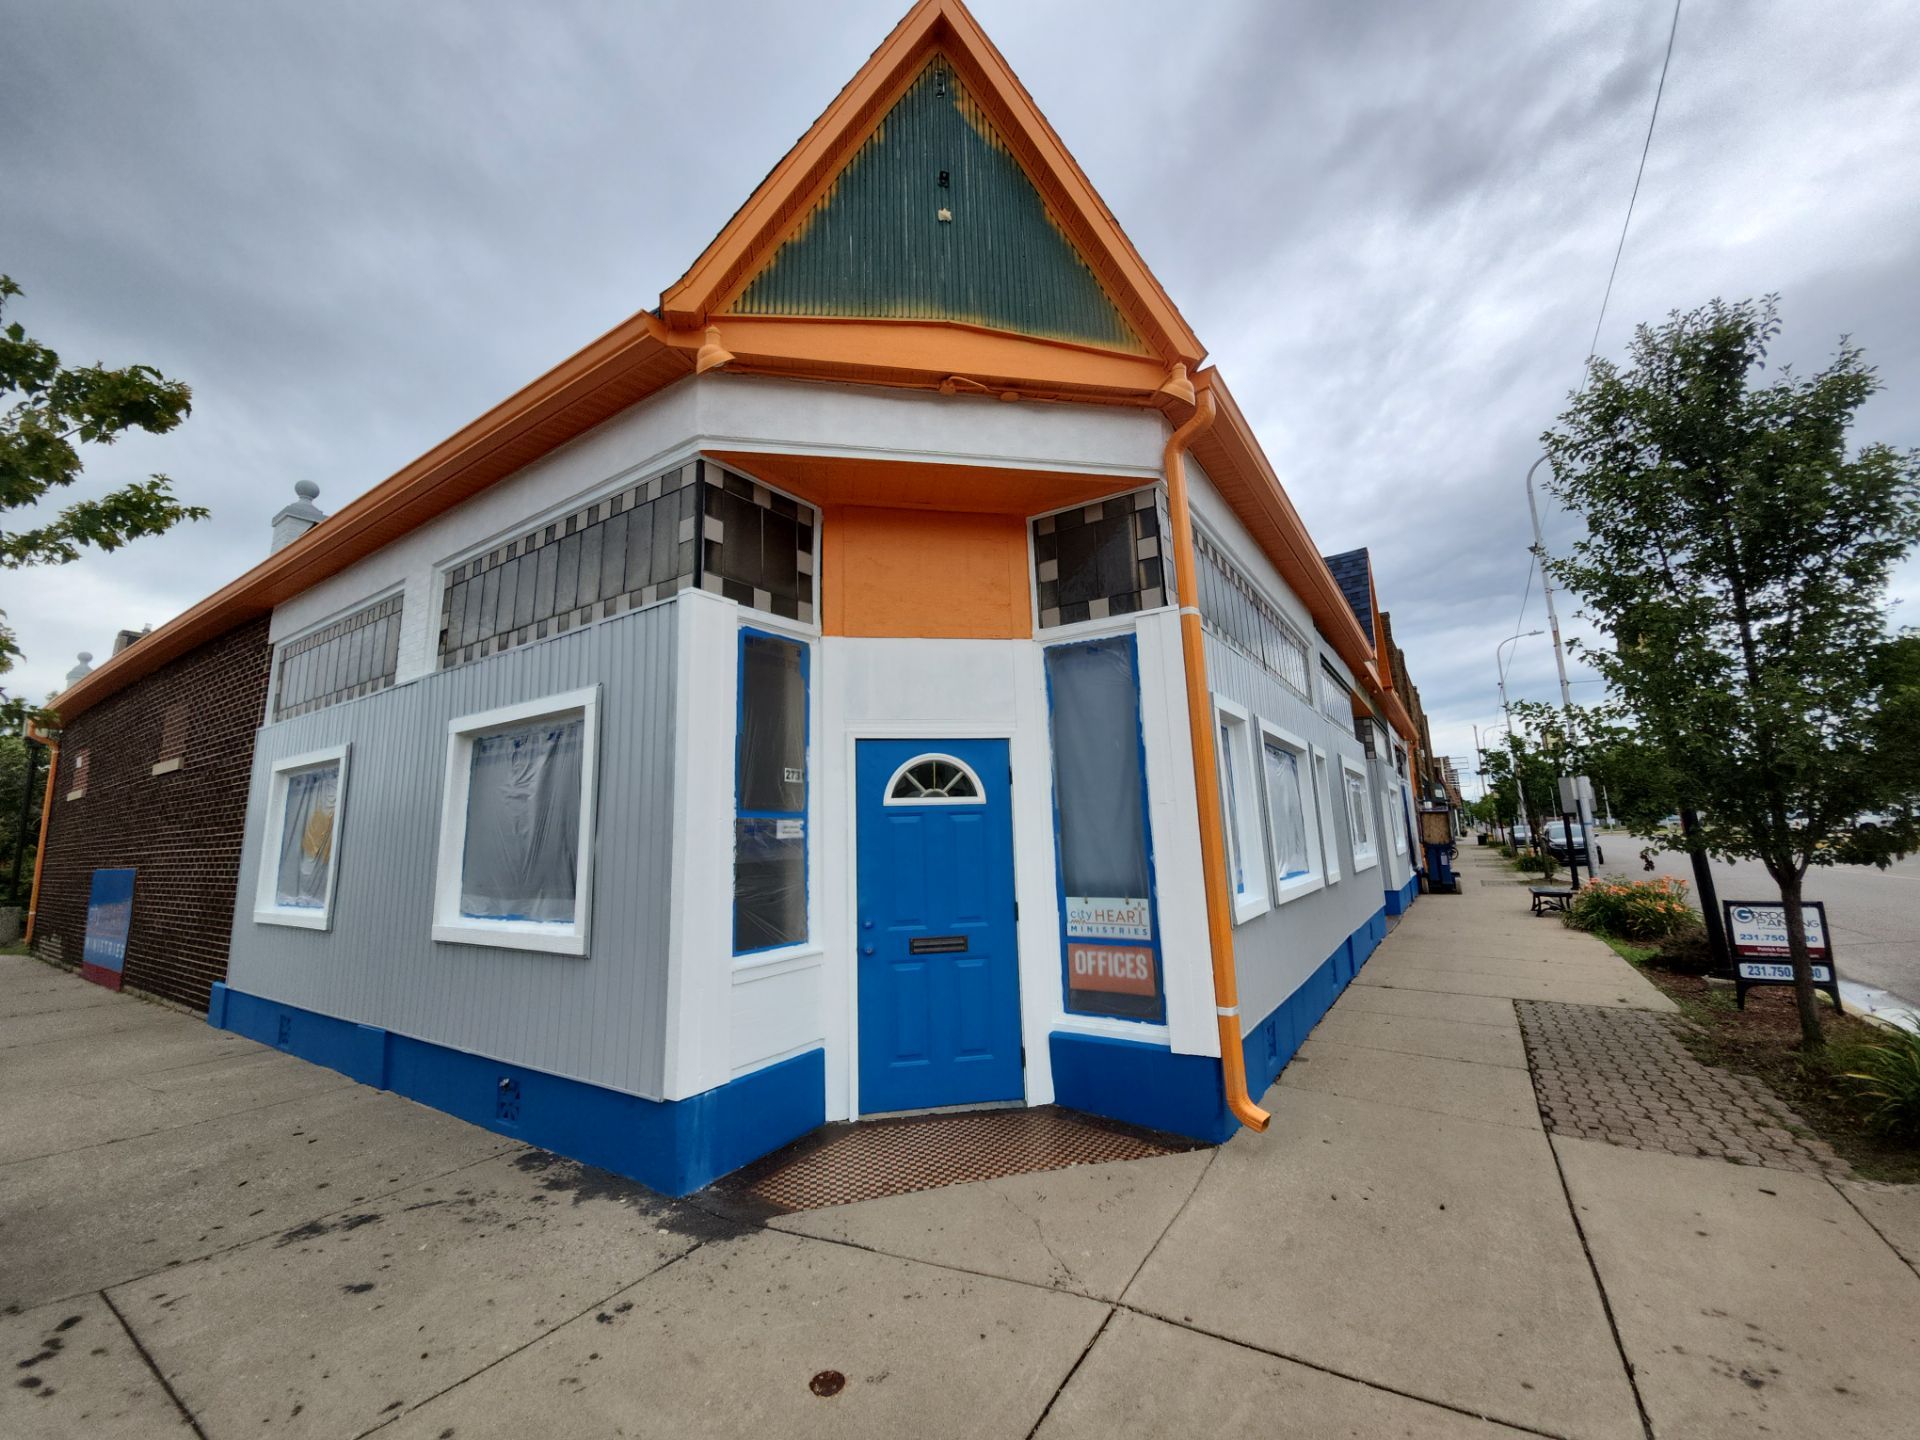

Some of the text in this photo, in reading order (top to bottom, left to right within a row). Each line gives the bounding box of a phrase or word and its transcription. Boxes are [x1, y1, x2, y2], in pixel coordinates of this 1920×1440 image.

[1070, 909, 1092, 921] city
[1070, 925, 1148, 936] MINISTRIES
[1074, 950, 1149, 980] OFFICES
[1747, 965, 1822, 979] 231.750.0
